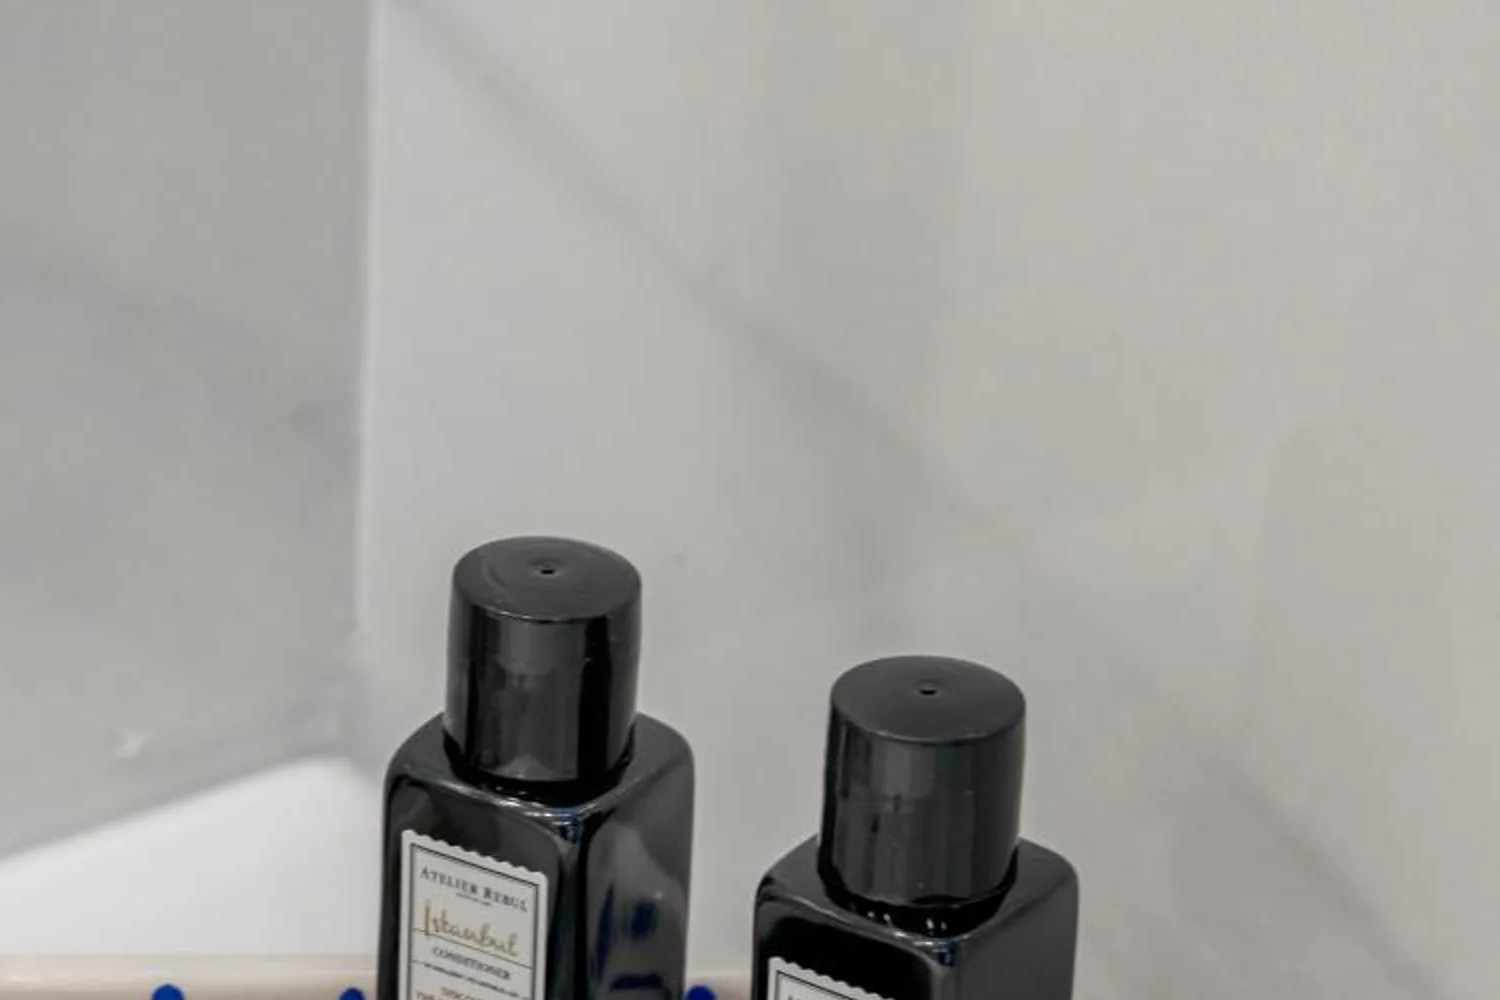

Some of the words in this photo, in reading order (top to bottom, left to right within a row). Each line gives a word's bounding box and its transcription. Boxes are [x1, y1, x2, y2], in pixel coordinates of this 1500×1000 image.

[420, 865, 479, 895] ATELIER
[483, 886, 528, 913] REBUL
[432, 947, 511, 980] CONDITIONER
